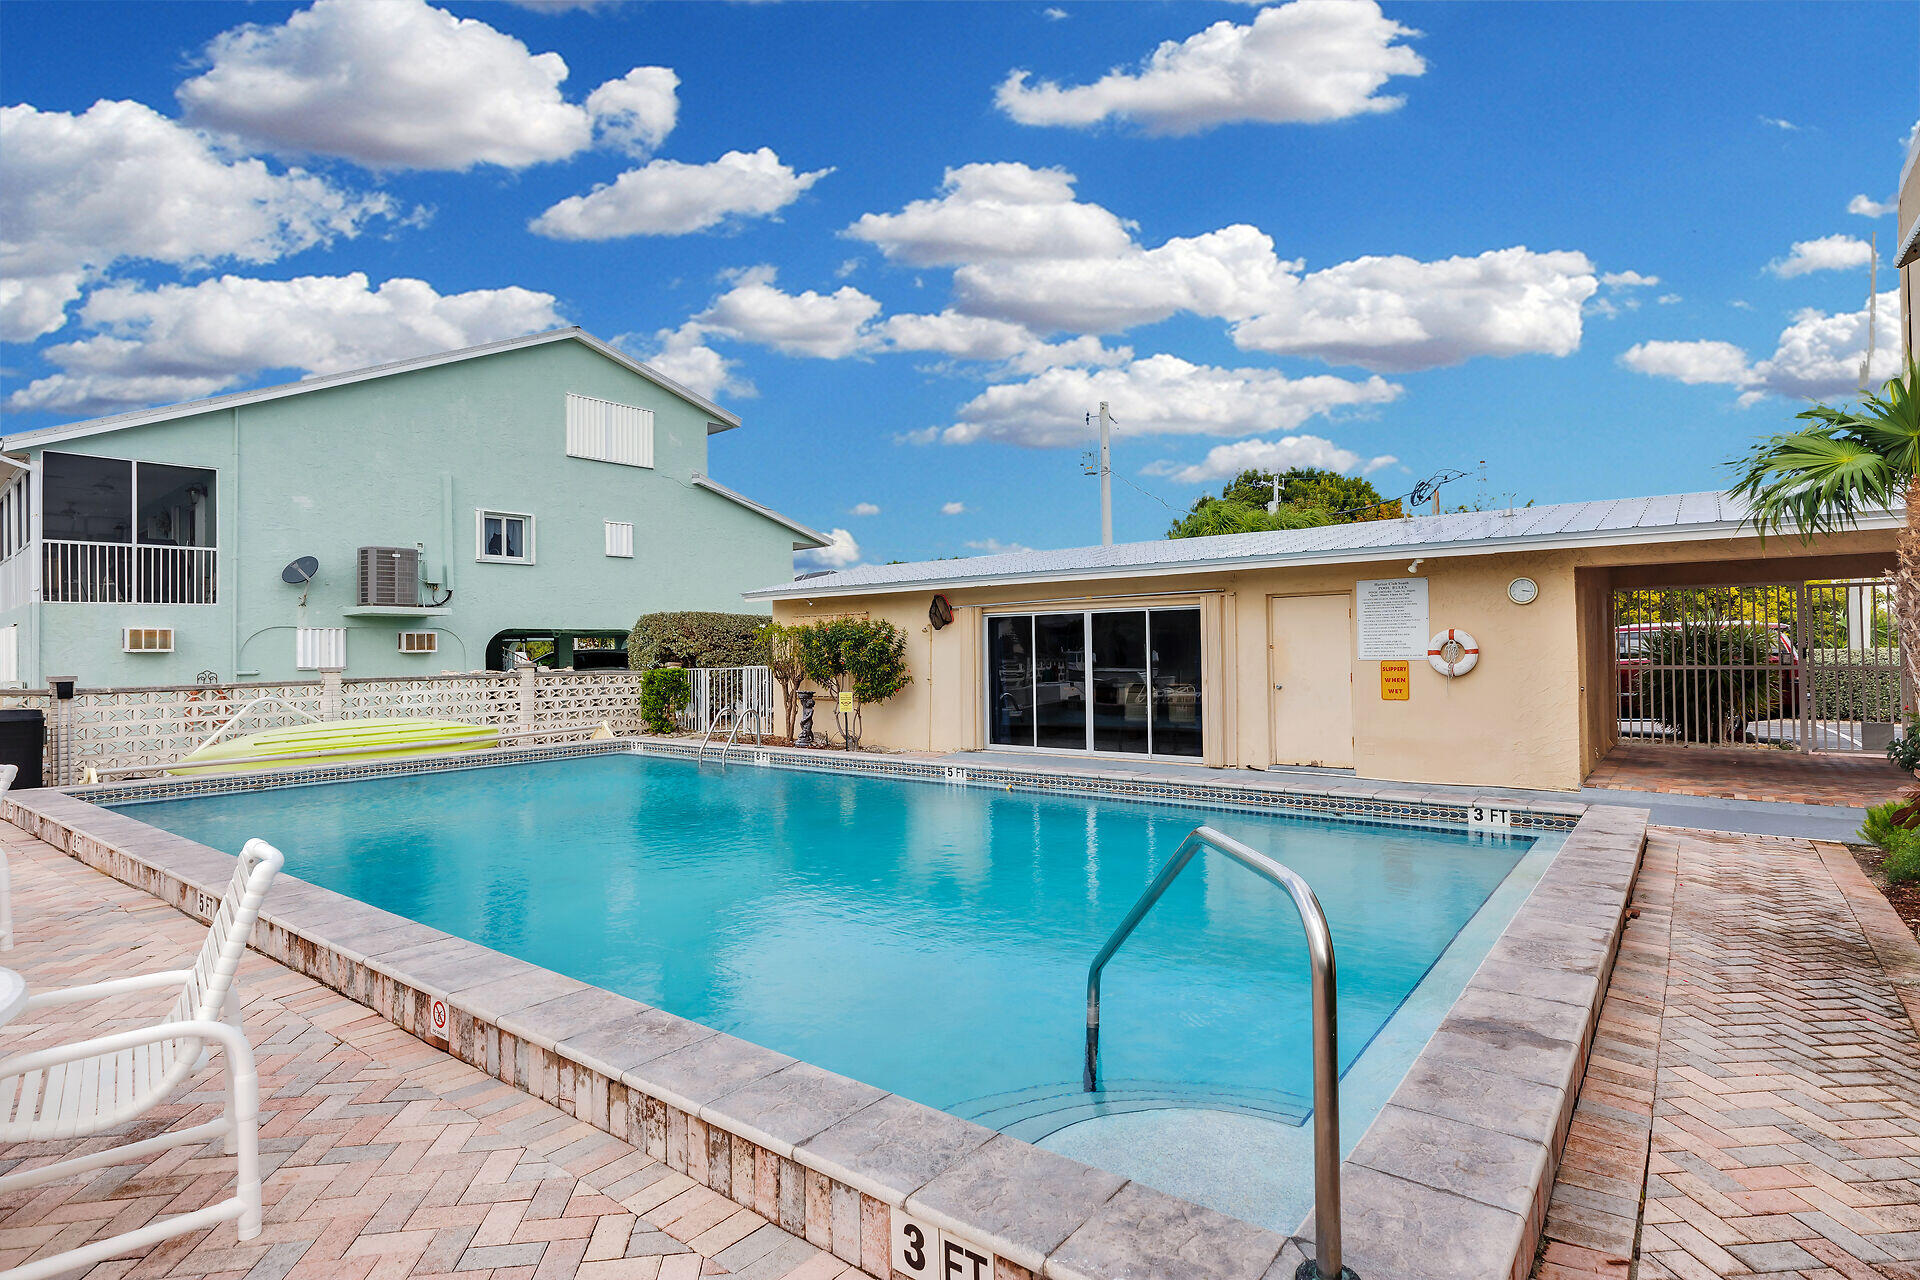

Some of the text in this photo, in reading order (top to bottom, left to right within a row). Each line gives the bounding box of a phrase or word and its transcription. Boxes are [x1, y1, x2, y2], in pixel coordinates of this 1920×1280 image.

[762, 752, 768, 761] FT
[947, 767, 965, 778] 5 FT
[1473, 808, 1508, 824] 3 FT
[199, 893, 213, 917] 5 FT
[903, 1223, 988, 1280] 3 FT
